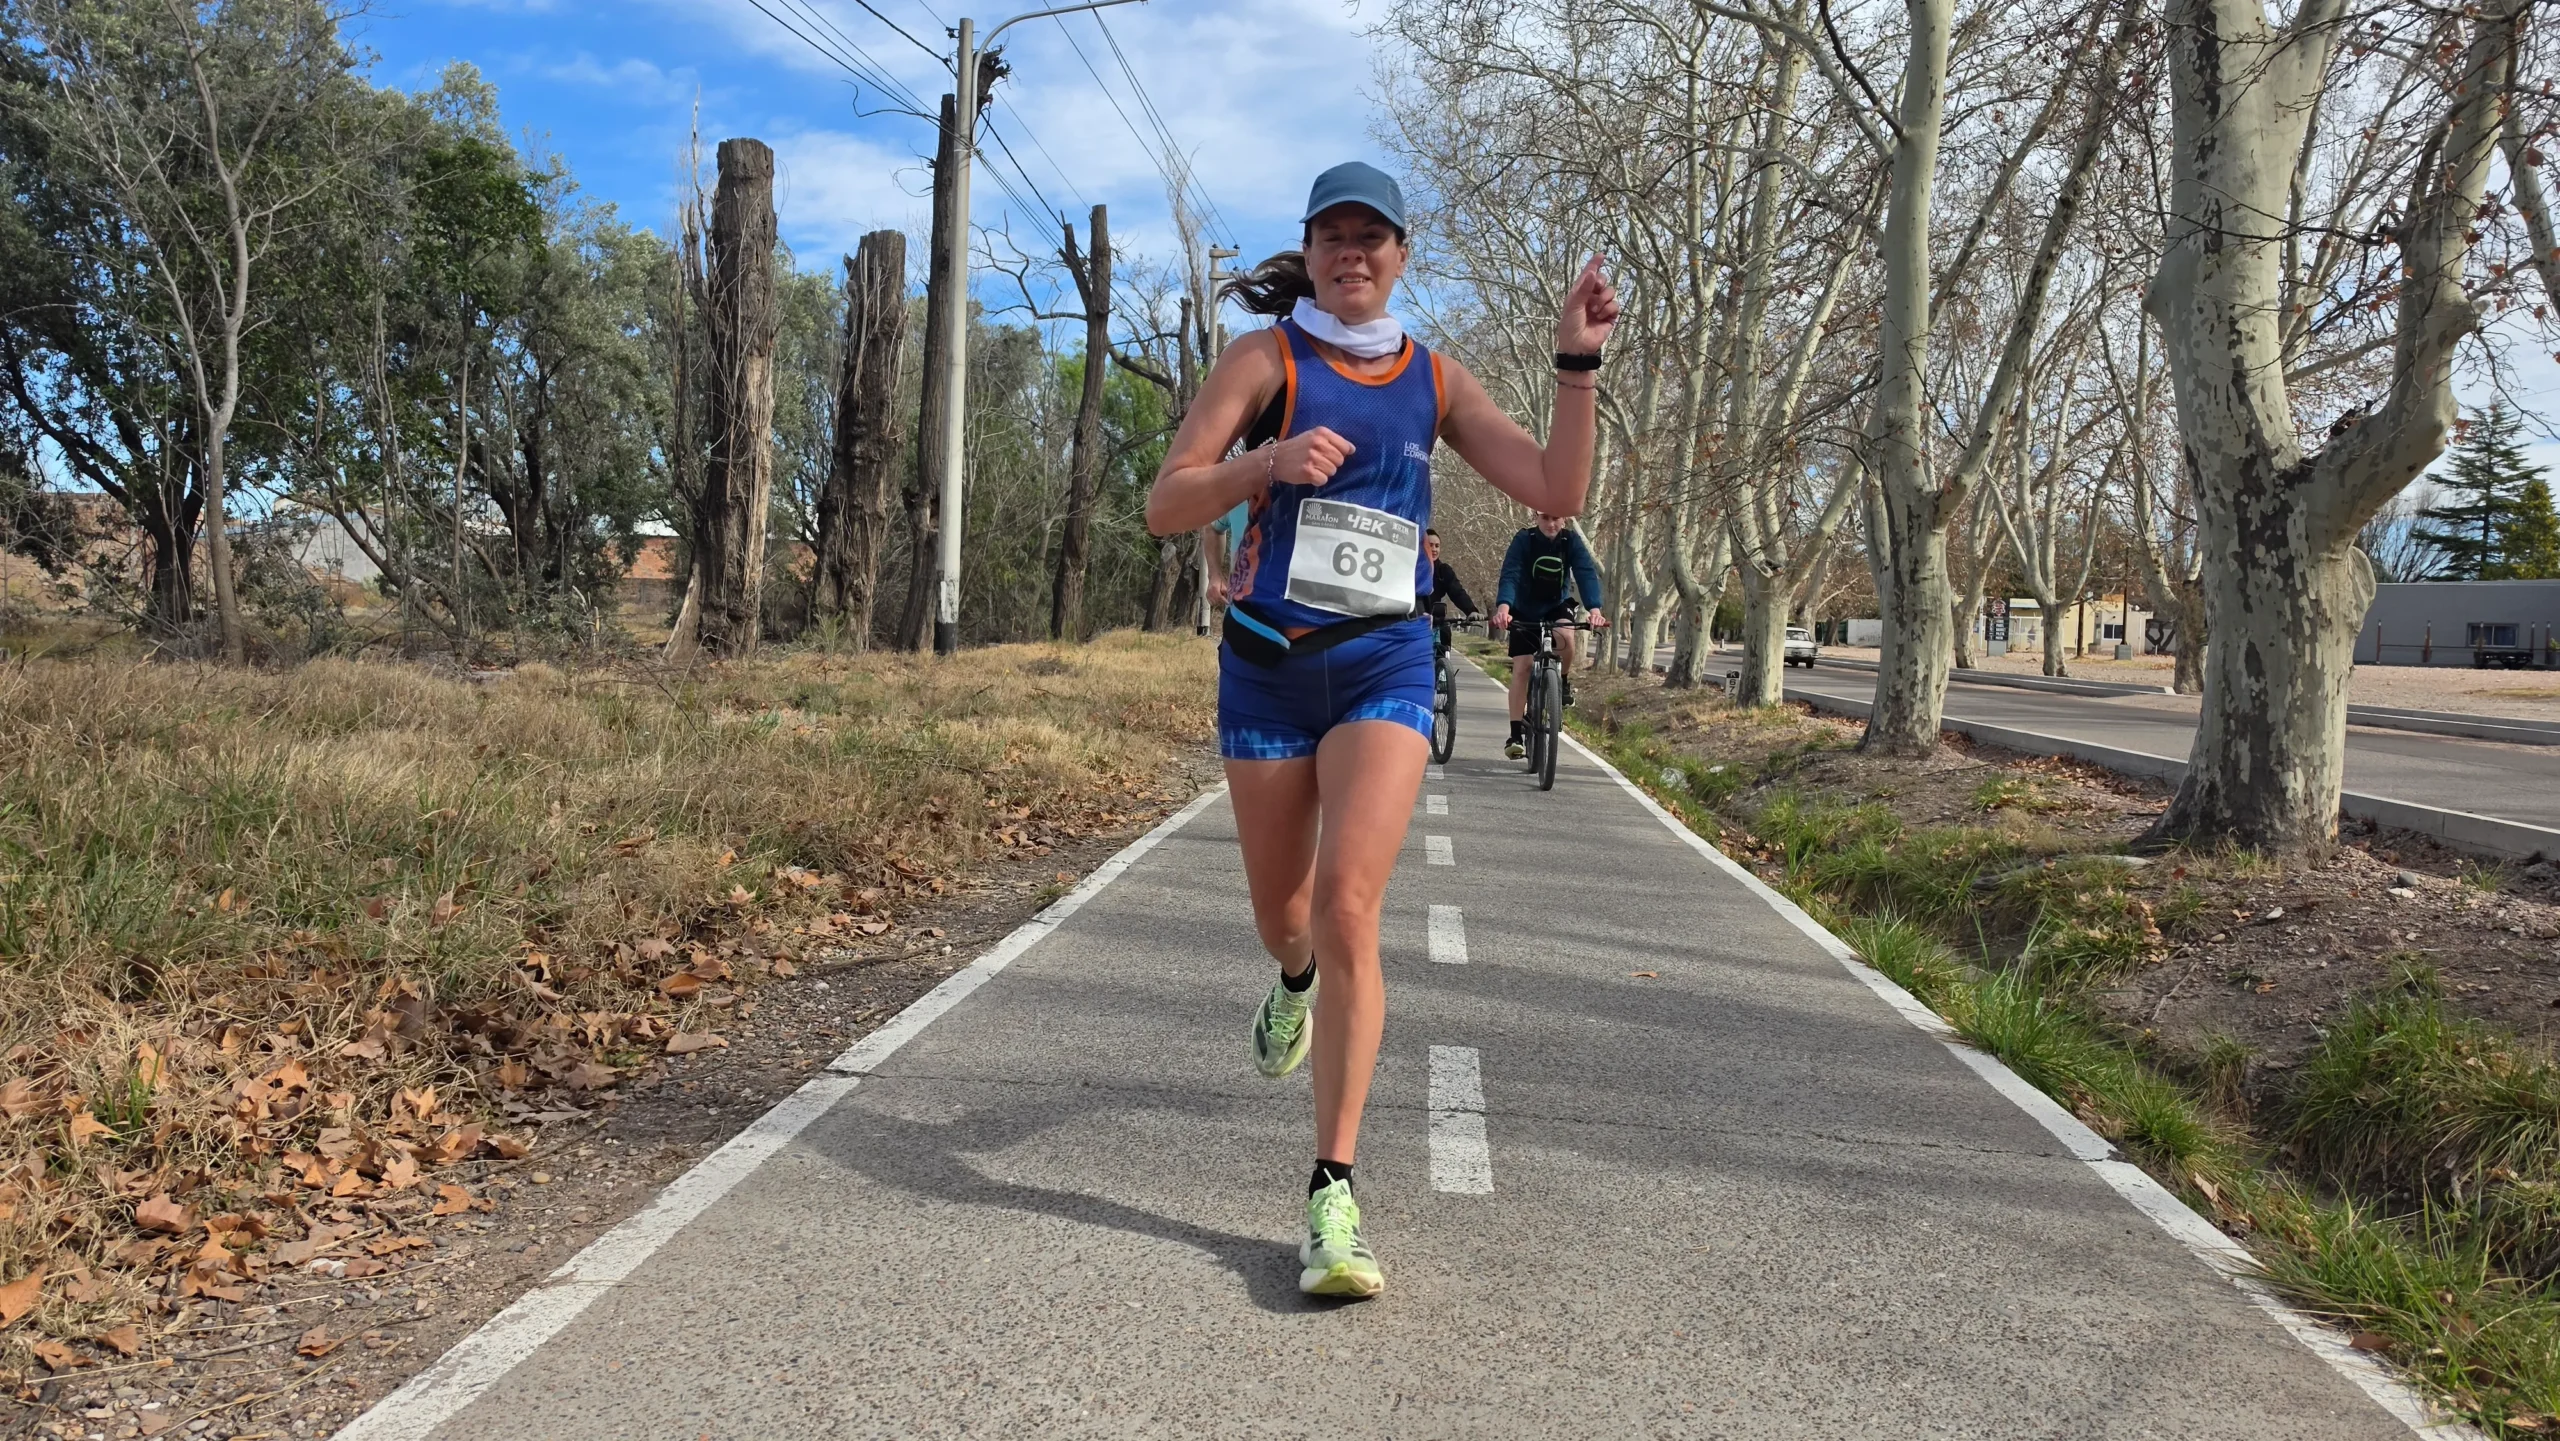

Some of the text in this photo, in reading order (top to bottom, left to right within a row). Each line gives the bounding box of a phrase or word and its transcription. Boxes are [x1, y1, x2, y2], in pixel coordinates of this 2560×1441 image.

[1405, 441, 1419, 450] LOS
[1347, 514, 1386, 536] 42K
[1333, 541, 1384, 583] 68
